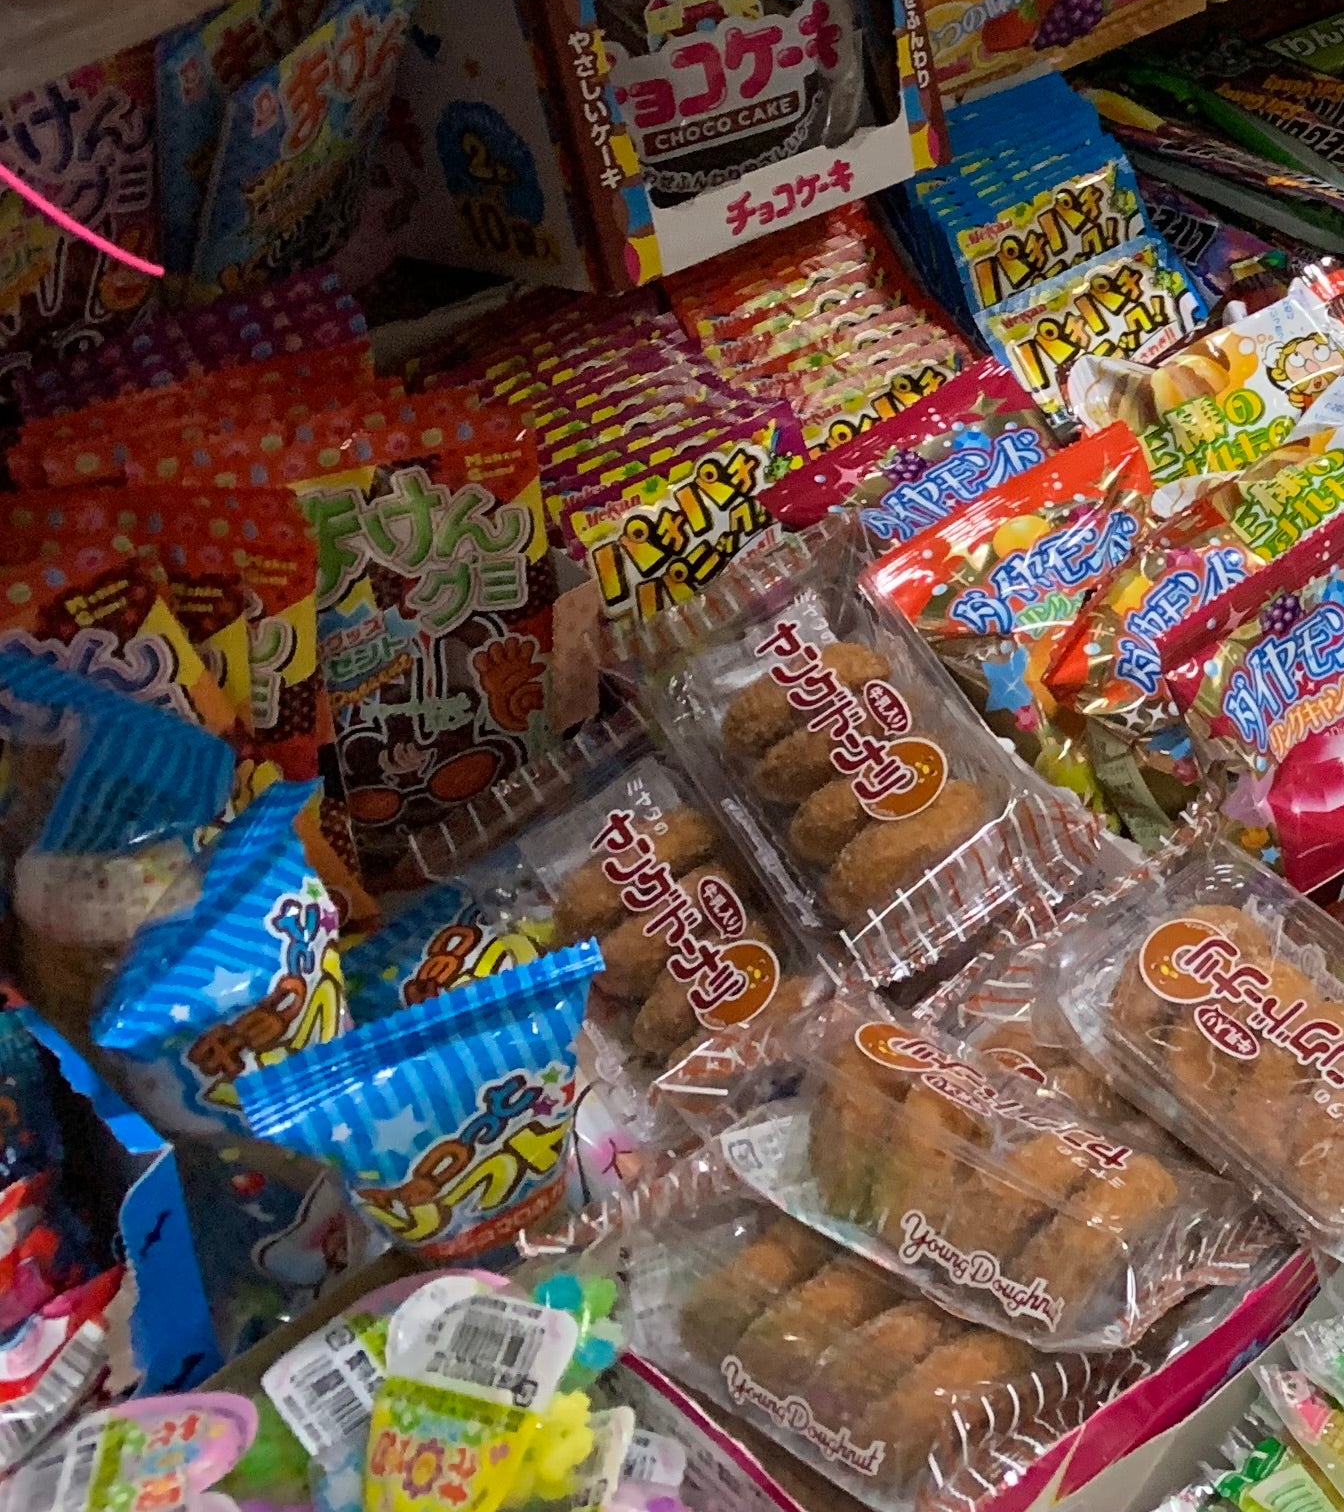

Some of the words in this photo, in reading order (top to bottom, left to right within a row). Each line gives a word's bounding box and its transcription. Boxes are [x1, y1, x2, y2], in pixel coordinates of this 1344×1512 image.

[567, 30, 627, 189] やさしいケーキ
[653, 116, 733, 154] CHOCO
[737, 95, 796, 131] CAKE
[724, 158, 856, 236] チョコケーキ
[1016, 263, 1144, 388] パチパチ
[592, 447, 761, 606] パチパチ
[951, 510, 1140, 637] ダイヤモンド
[755, 616, 919, 805] ヤングドーナツ
[868, 684, 910, 730] 牛乳入り
[590, 808, 751, 1014] ヤングドーナツ
[702, 878, 744, 936] 牛乳入り
[900, 1209, 967, 1284] Young
[721, 1354, 788, 1431] Young
[790, 1390, 883, 1477] Doughnut
